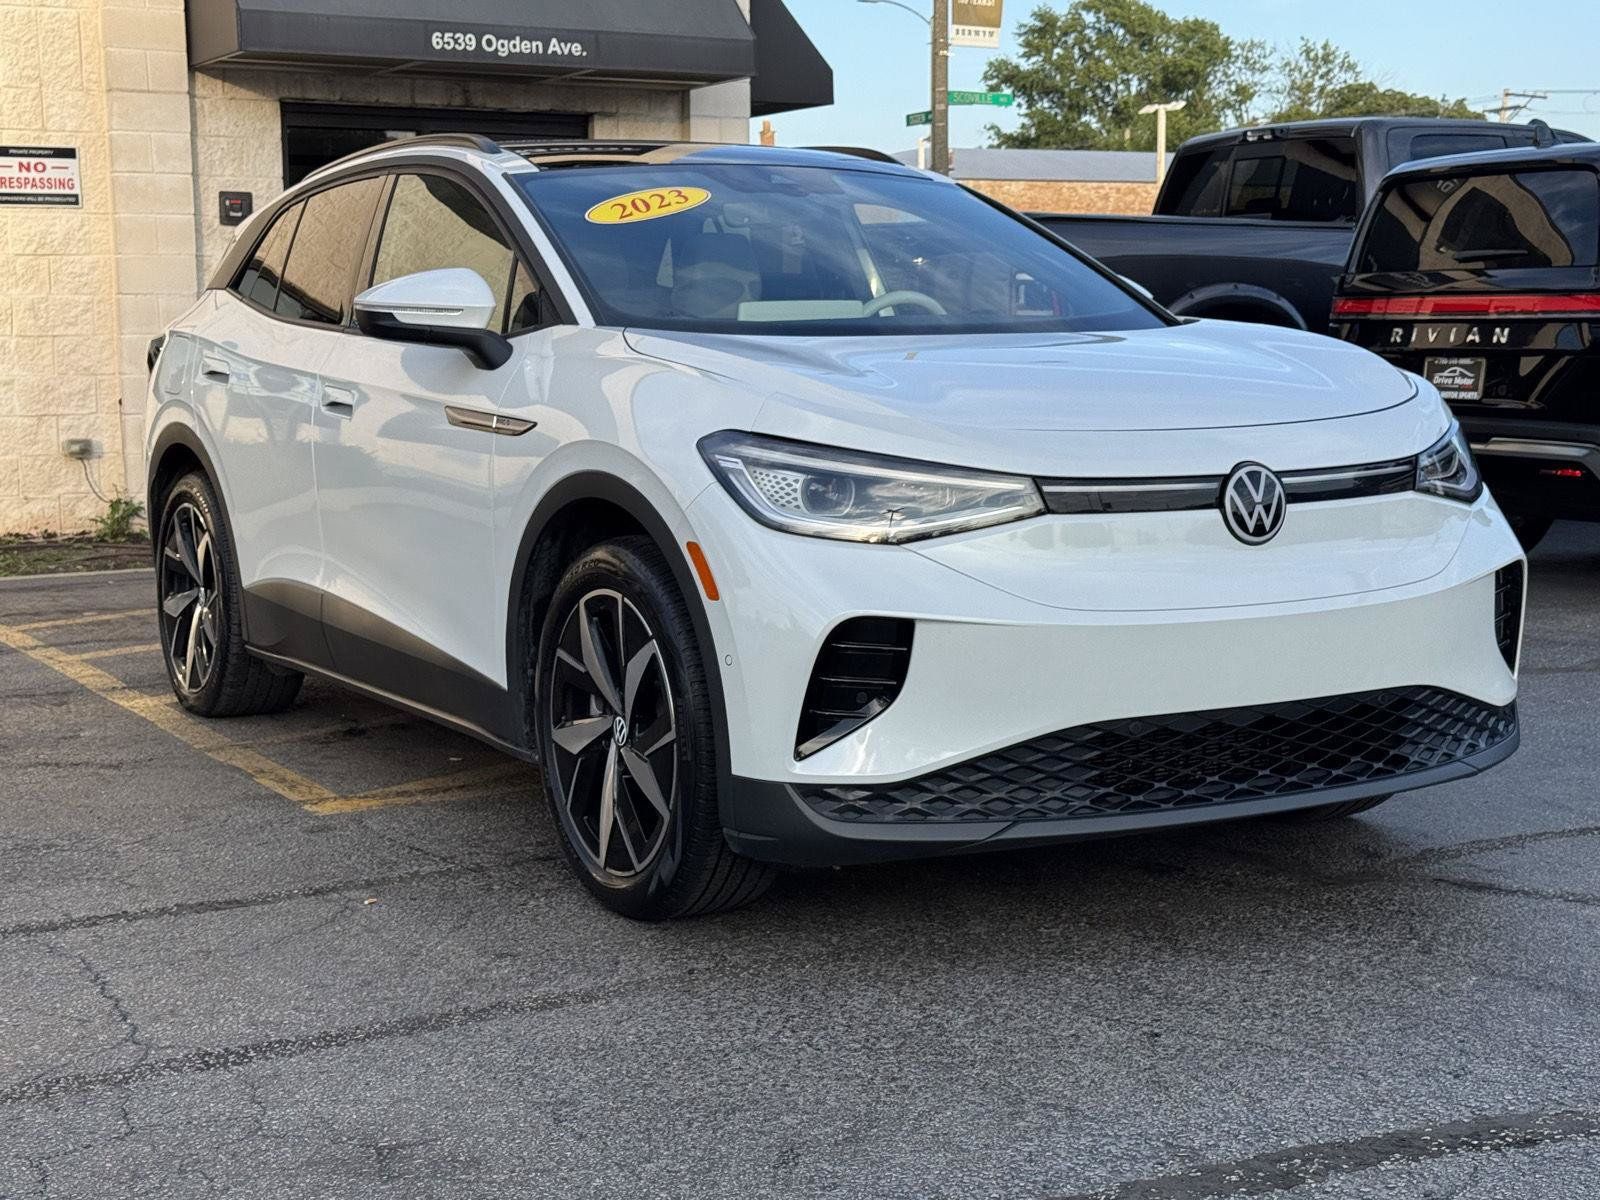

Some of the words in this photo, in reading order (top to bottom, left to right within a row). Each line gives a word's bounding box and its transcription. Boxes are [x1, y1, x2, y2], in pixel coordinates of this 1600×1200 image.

[431, 31, 477, 51] 6539
[481, 33, 543, 57] Ogden
[547, 37, 588, 57] Ave.
[18, 161, 47, 173] NO
[0, 176, 76, 191] RESPASSING
[610, 189, 689, 219] 2023
[1390, 326, 1510, 344] RIVIAN
[1227, 467, 1284, 538] VW
